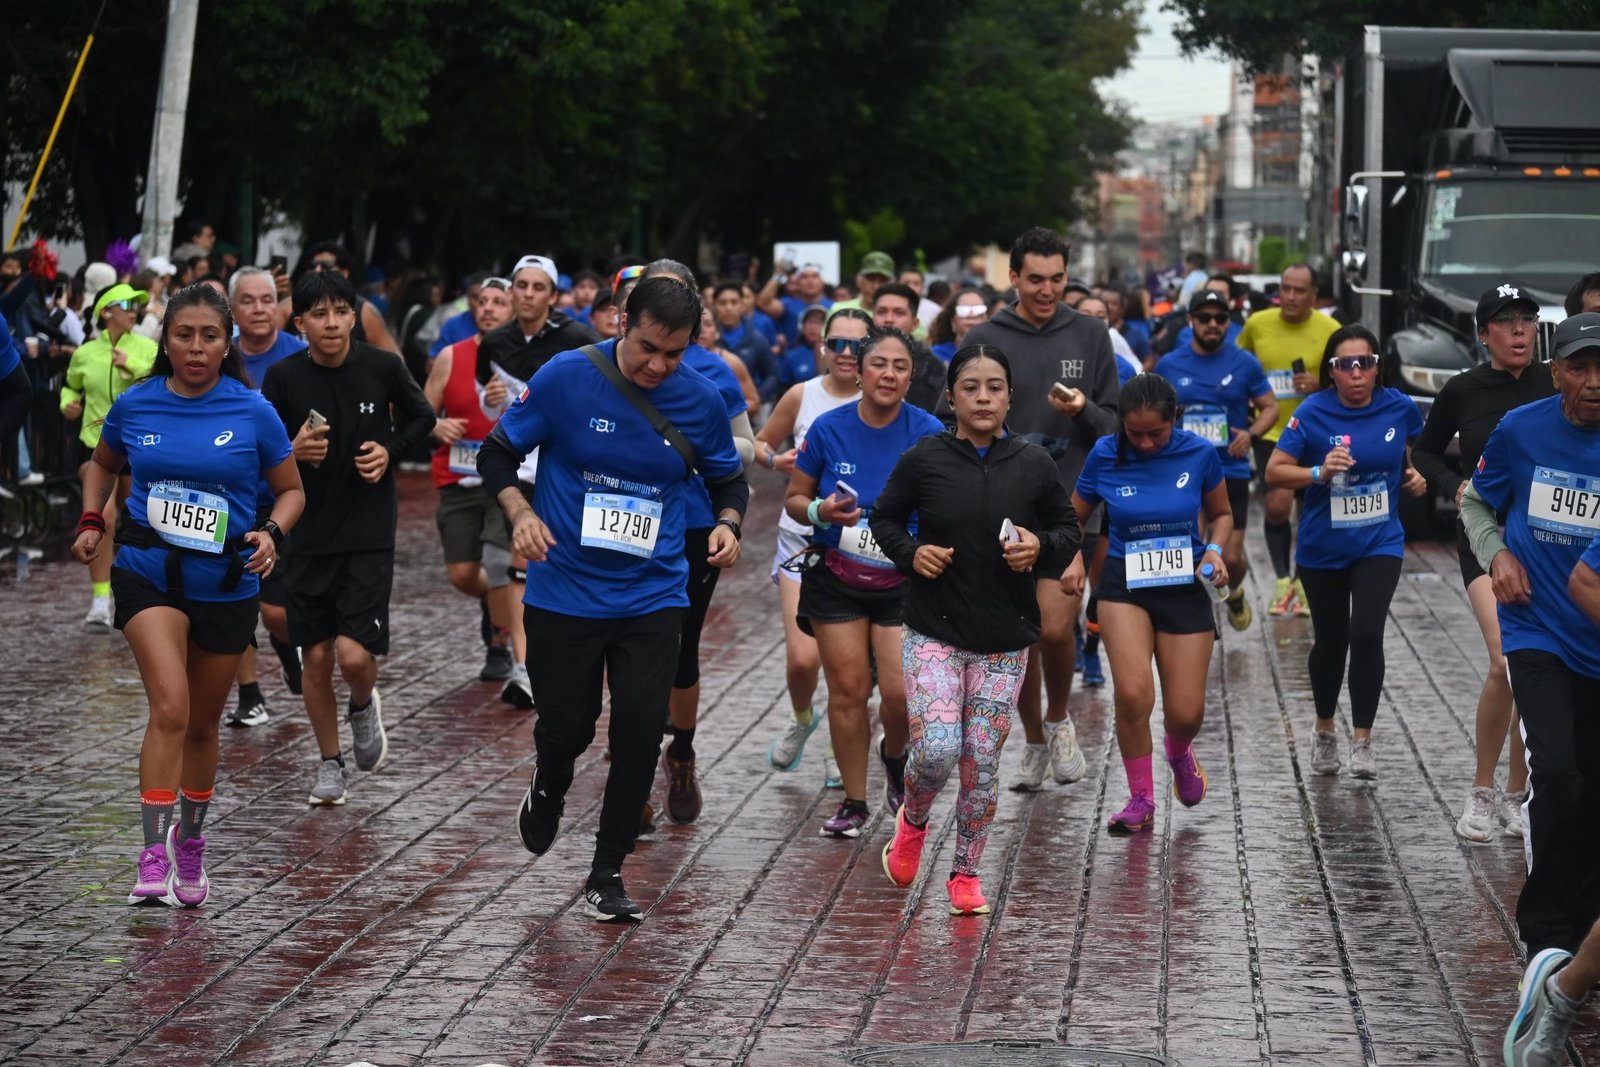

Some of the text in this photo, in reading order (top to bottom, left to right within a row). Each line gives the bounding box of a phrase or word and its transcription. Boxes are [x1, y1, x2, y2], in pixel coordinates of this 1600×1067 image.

[160, 500, 218, 534] 14562
[1343, 493, 1383, 515] 13979
[1551, 487, 1600, 519] 9467
[599, 508, 652, 540] 12790
[858, 529, 882, 553] 94
[1139, 549, 1183, 572] 11749
